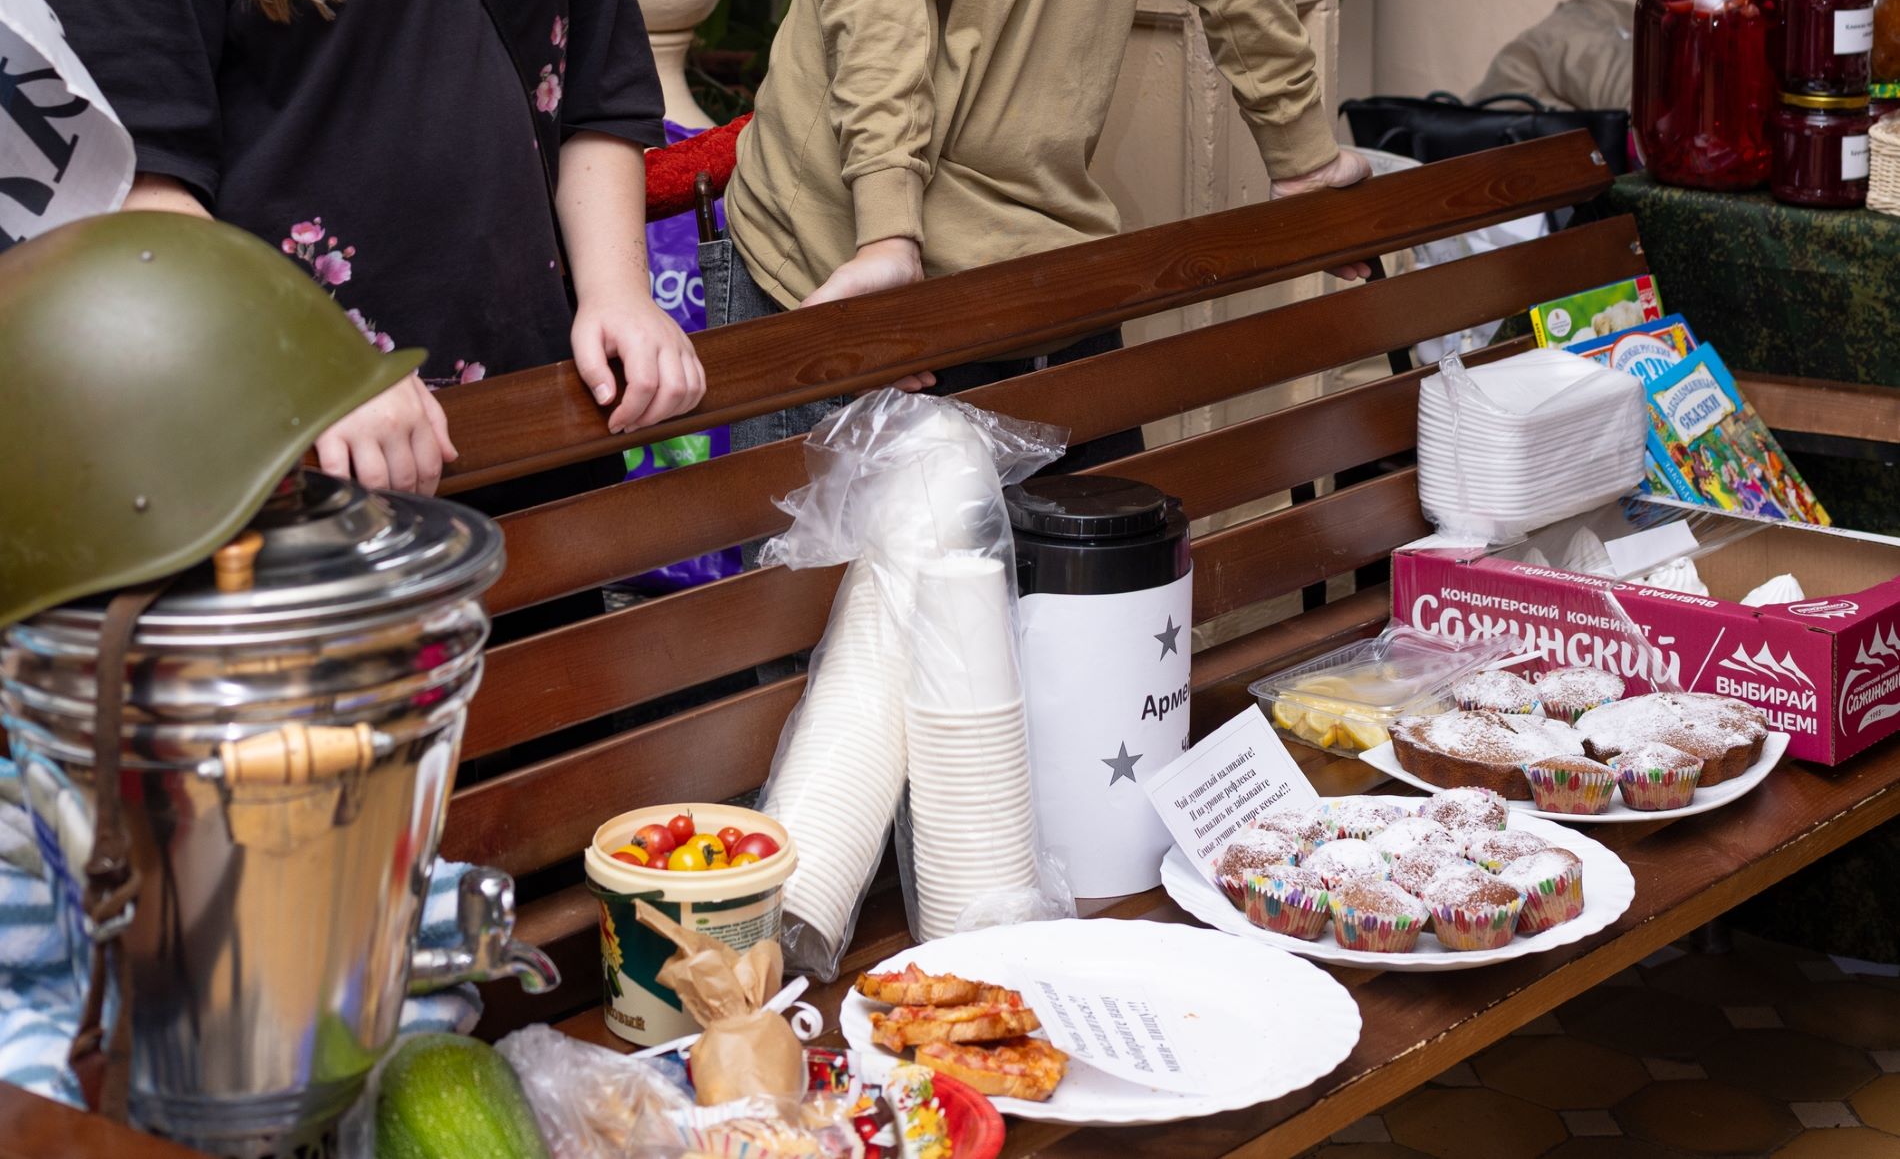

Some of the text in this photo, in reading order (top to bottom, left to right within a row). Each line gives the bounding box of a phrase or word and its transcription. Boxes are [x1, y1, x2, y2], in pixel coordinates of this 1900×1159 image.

[1680, 394, 1720, 430] СКАЗКИ
[1441, 587, 1652, 637] КОНДИТЕРСКИЙ КОМБИНАТ
[1639, 589, 1719, 608] ВЫБИРАЙ
[1412, 594, 1680, 687] Сажинский
[1716, 676, 1817, 712] ВЫБИРАЙ
[1174, 796, 1189, 810] Чай
[1217, 747, 1256, 779] наливайте!
[1224, 768, 1257, 798] рефлекса
[1233, 778, 1271, 809] забывайте
[1241, 807, 1260, 825] мире
[1259, 782, 1291, 811] кексы!!!
